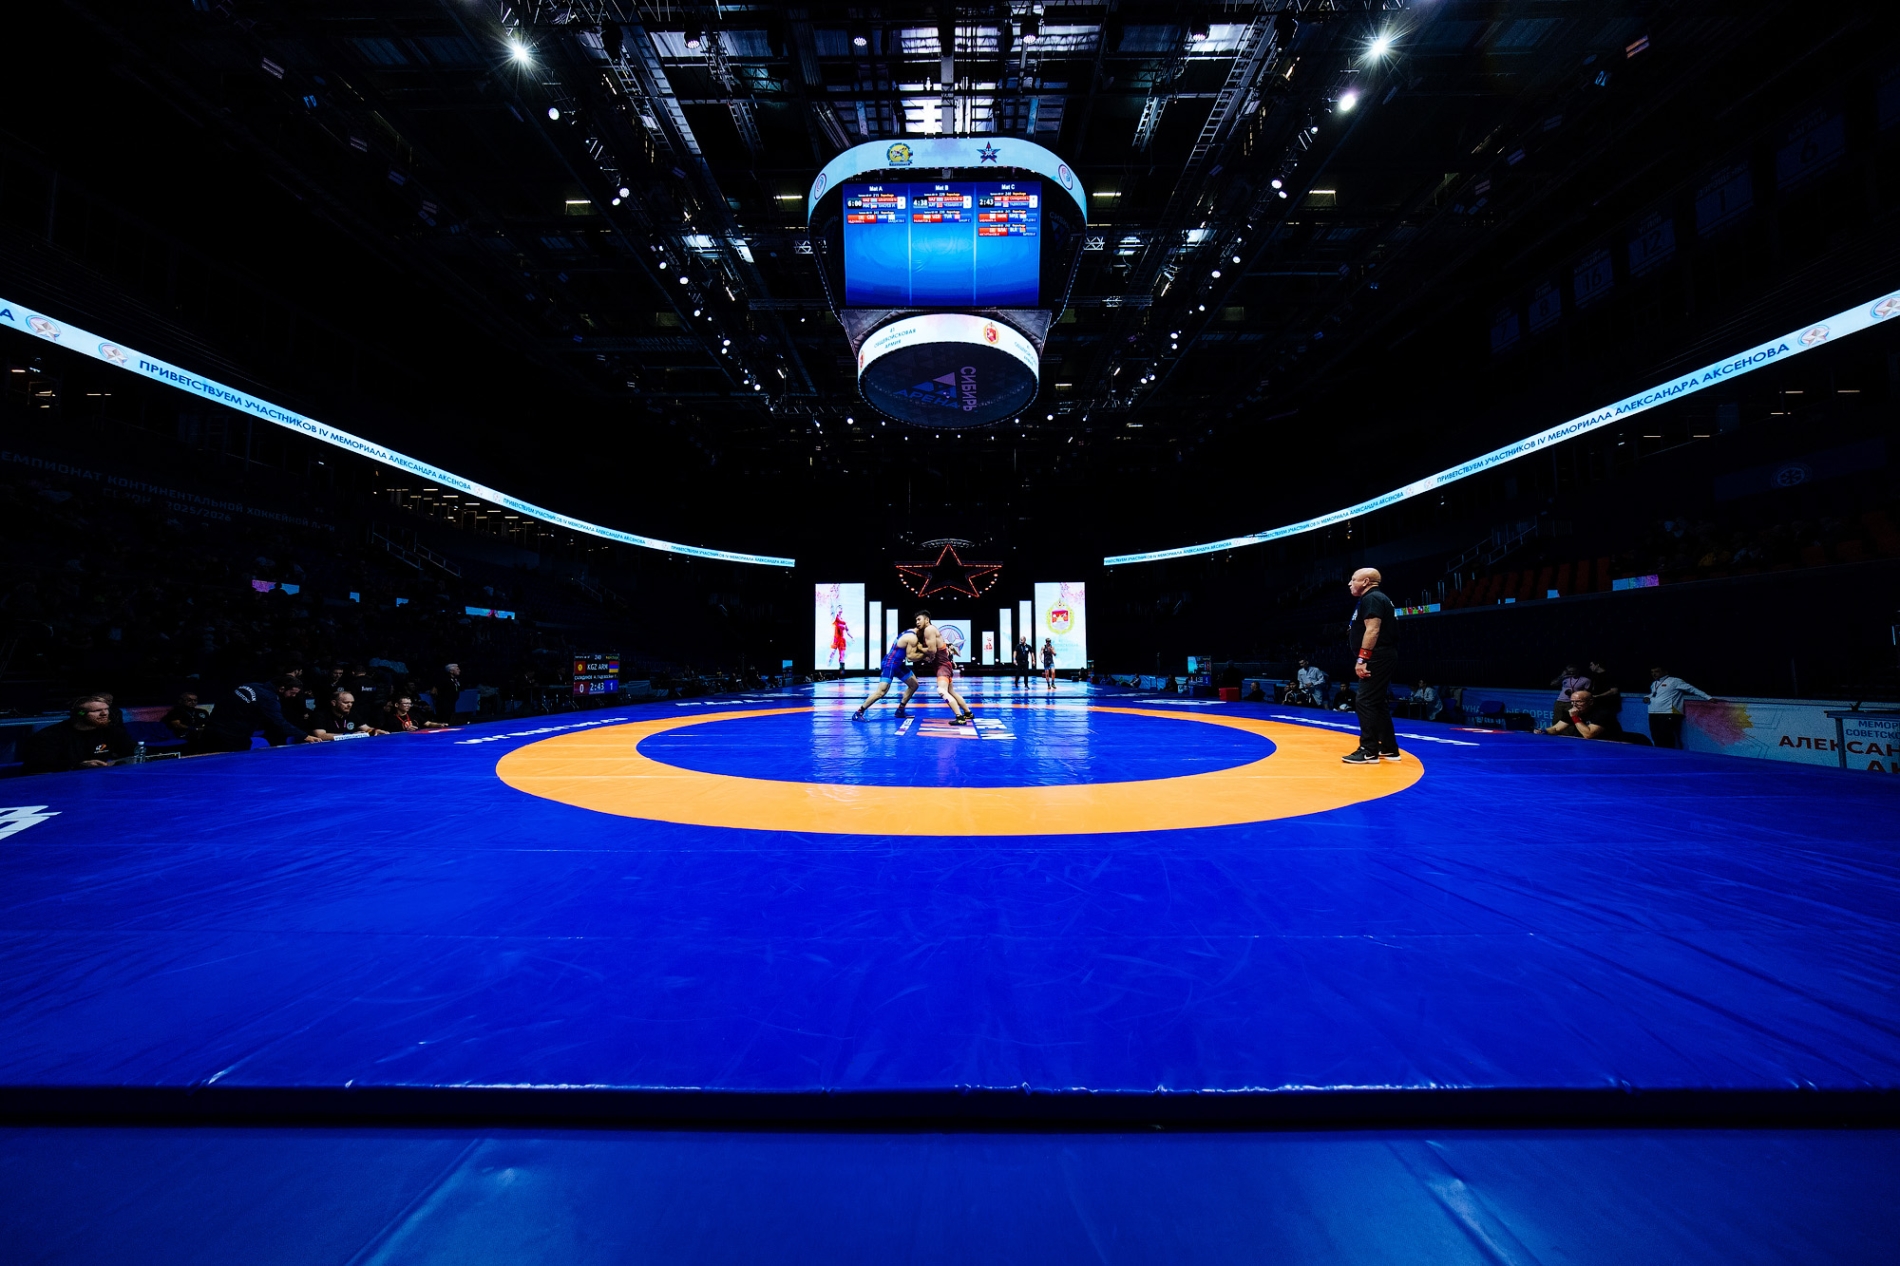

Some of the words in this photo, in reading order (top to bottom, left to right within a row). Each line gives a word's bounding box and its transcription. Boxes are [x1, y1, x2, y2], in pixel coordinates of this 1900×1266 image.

[893, 388, 960, 410] АРЕНА
[960, 366, 977, 412] СИБИРЬ
[1436, 460, 1484, 484] ПРИВЕТСТВУЕМ
[1484, 441, 1536, 466] УЧАСТНИКОВ
[1537, 436, 1546, 446] IV
[1548, 411, 1612, 442] МЕМОРИАЛА
[1614, 378, 1700, 416] АЛЕКСАНДРА
[1702, 343, 1790, 383] АКСЕНОВА
[139, 360, 243, 406] ПРИВЕТСТВУЕМ
[244, 399, 318, 433] УЧАСТНИКОВ
[318, 428, 329, 437] IV
[330, 432, 388, 460] МЕМОРИАЛА
[388, 454, 437, 478] АЛЕКСАНДРА
[438, 474, 472, 491] АКСЕНОВА
[586, 663, 598, 671] KGZ
[579, 684, 584, 694] 0
[590, 682, 604, 692] 2:43
[1858, 720, 1900, 730] МЕМОР
